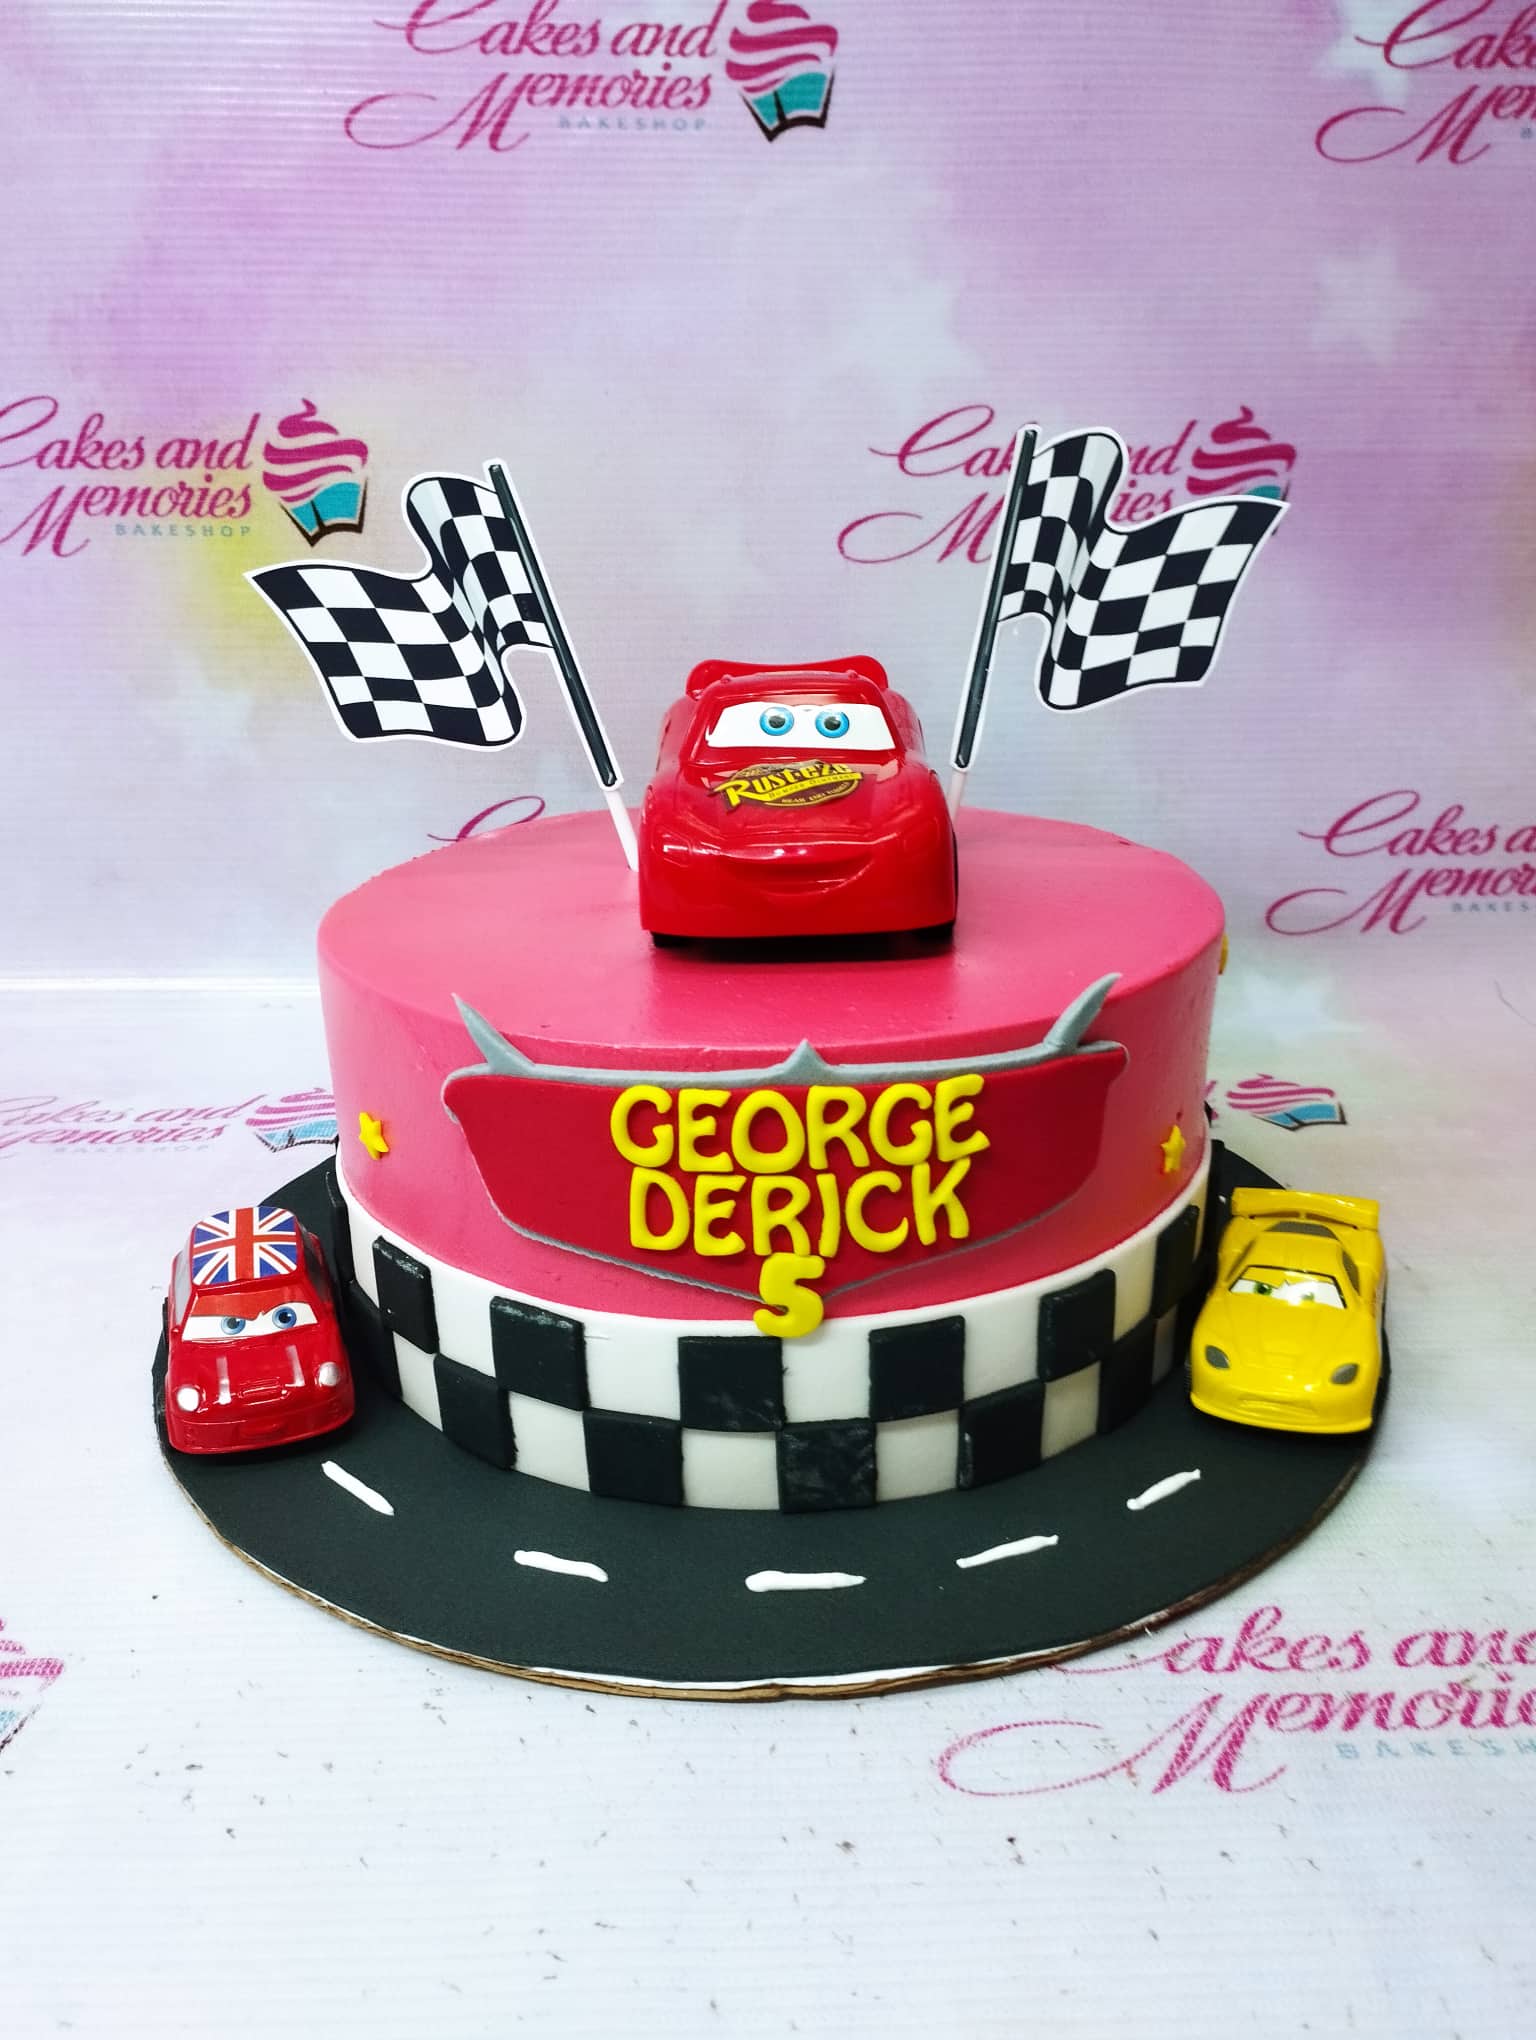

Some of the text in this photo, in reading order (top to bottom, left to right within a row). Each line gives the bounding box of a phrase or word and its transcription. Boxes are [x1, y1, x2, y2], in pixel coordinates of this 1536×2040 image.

[373, 0, 722, 57] Cakes and
[343, 62, 713, 152] Memories
[557, 116, 708, 131] BAKESHOP
[156, 412, 261, 470] and
[0, 473, 252, 558] Memories
[115, 523, 251, 538] BAKESHOP
[1297, 789, 1500, 857] Cakes
[134, 1094, 267, 1122] and
[610, 1073, 990, 1174] GEORGE
[629, 1157, 972, 1258] DERICK
